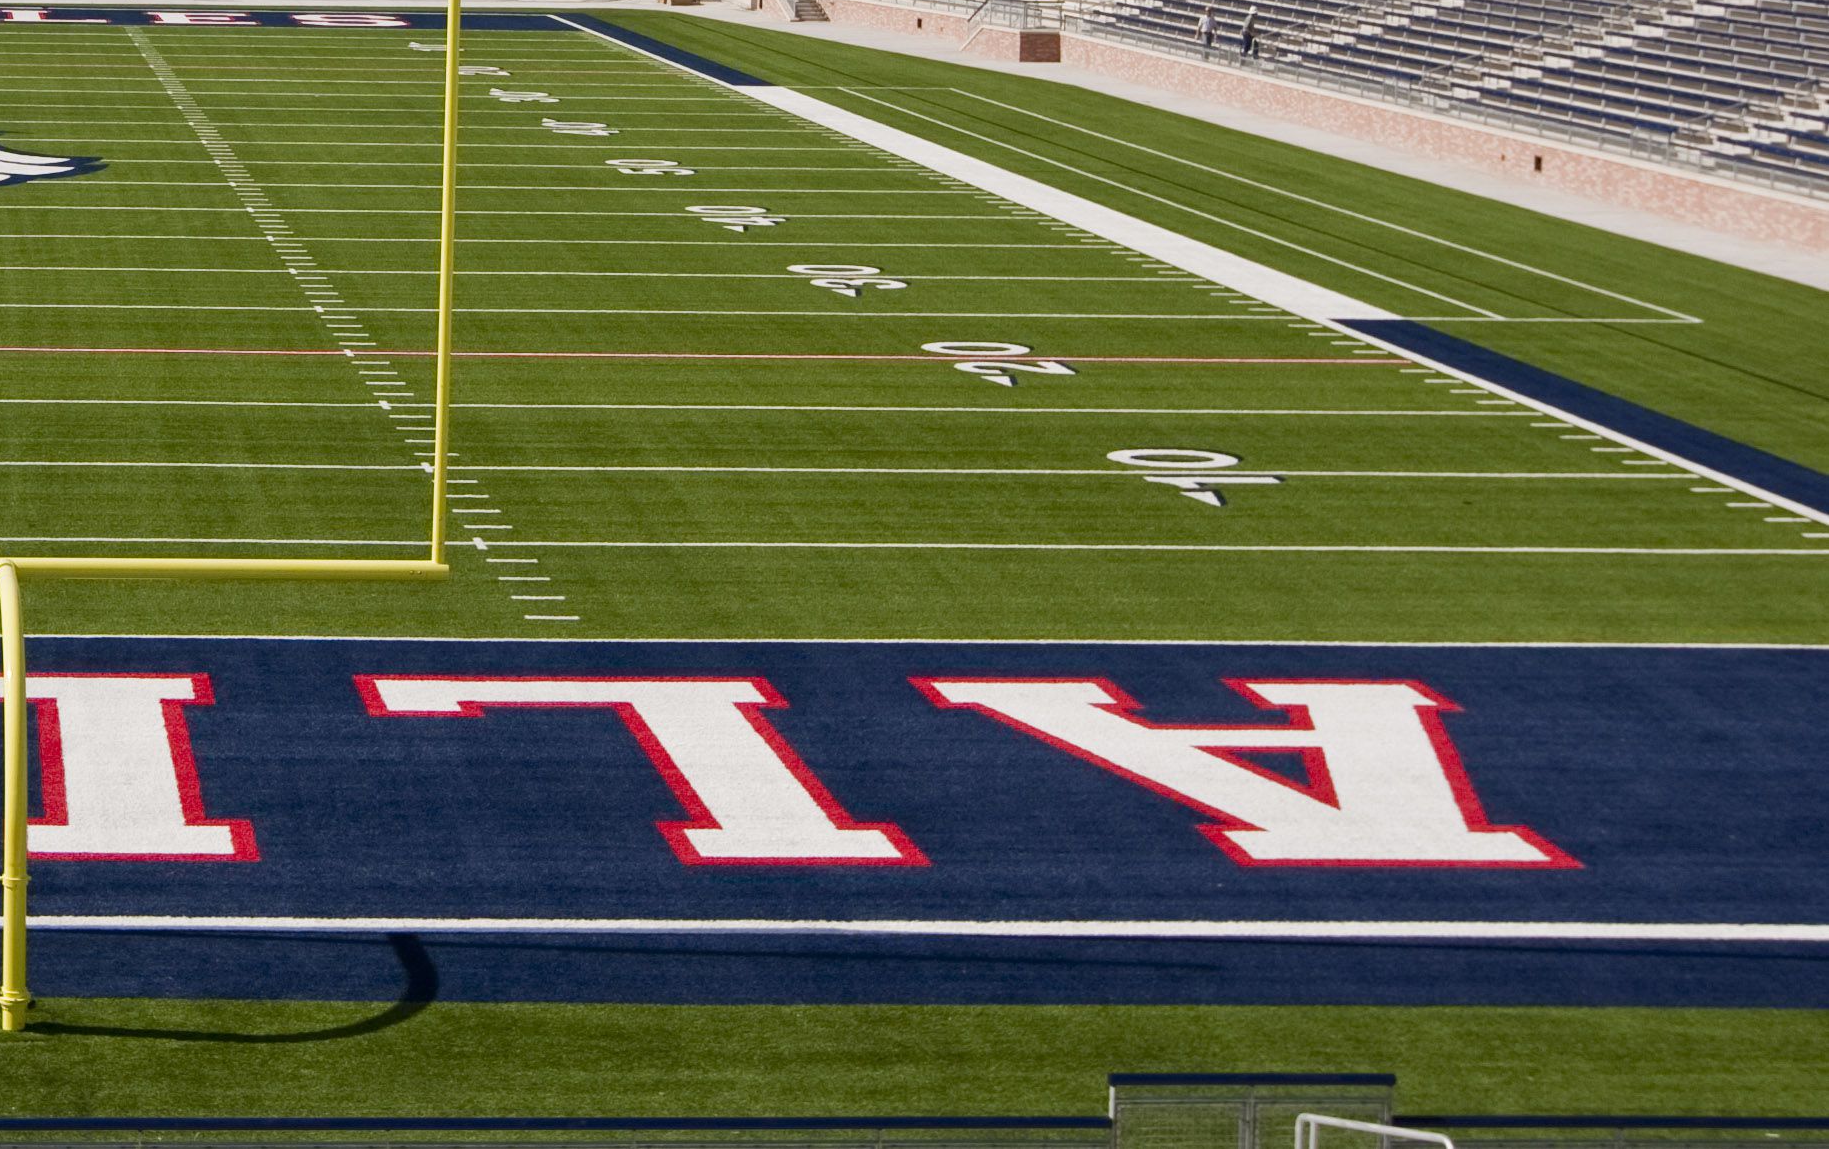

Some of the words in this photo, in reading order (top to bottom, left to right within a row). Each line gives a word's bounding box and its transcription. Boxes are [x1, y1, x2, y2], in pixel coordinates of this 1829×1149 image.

[489, 91, 560, 102] 30
[541, 122, 619, 136] 40
[604, 159, 695, 176] 50
[685, 205, 786, 226] 40
[786, 264, 908, 289] 30
[920, 341, 1076, 375] 20
[1106, 449, 1282, 488] 10
